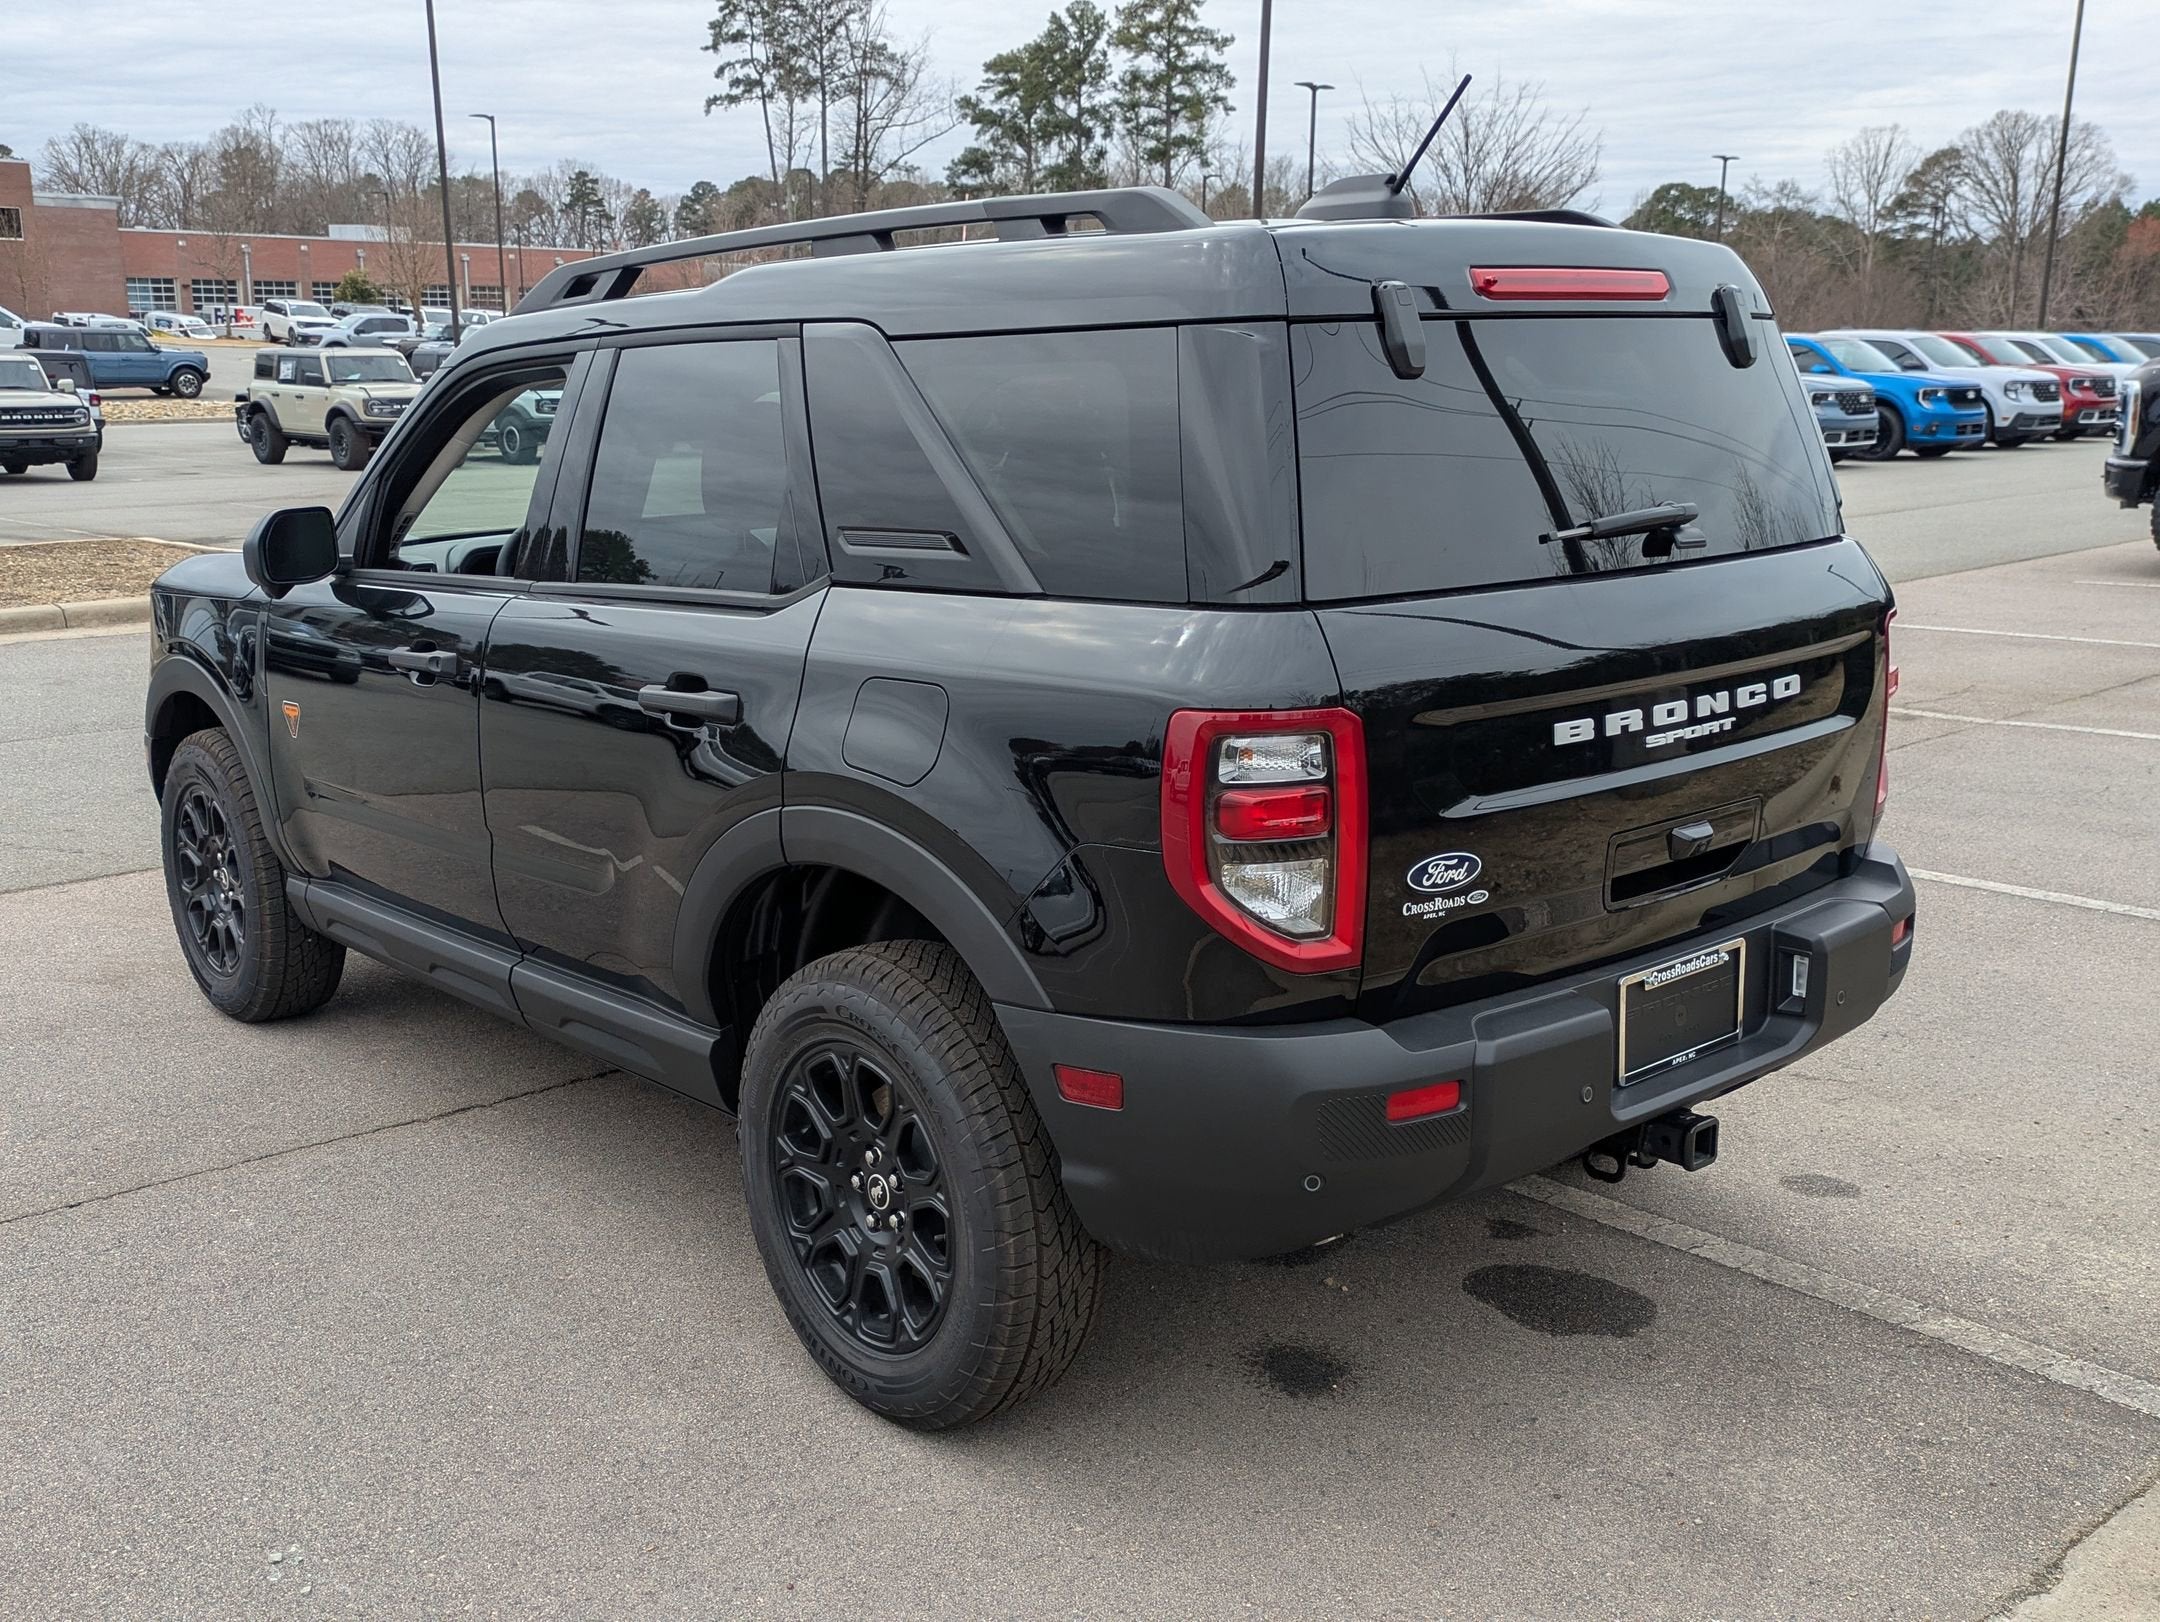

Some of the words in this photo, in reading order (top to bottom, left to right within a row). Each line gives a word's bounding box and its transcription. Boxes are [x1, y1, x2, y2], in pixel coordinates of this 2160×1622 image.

[1553, 673, 1801, 746] BRONCO
[1645, 716, 1737, 748] SPORT
[1422, 858, 1469, 887] Ford
[1651, 952, 1719, 986] CrossRoadsCars
